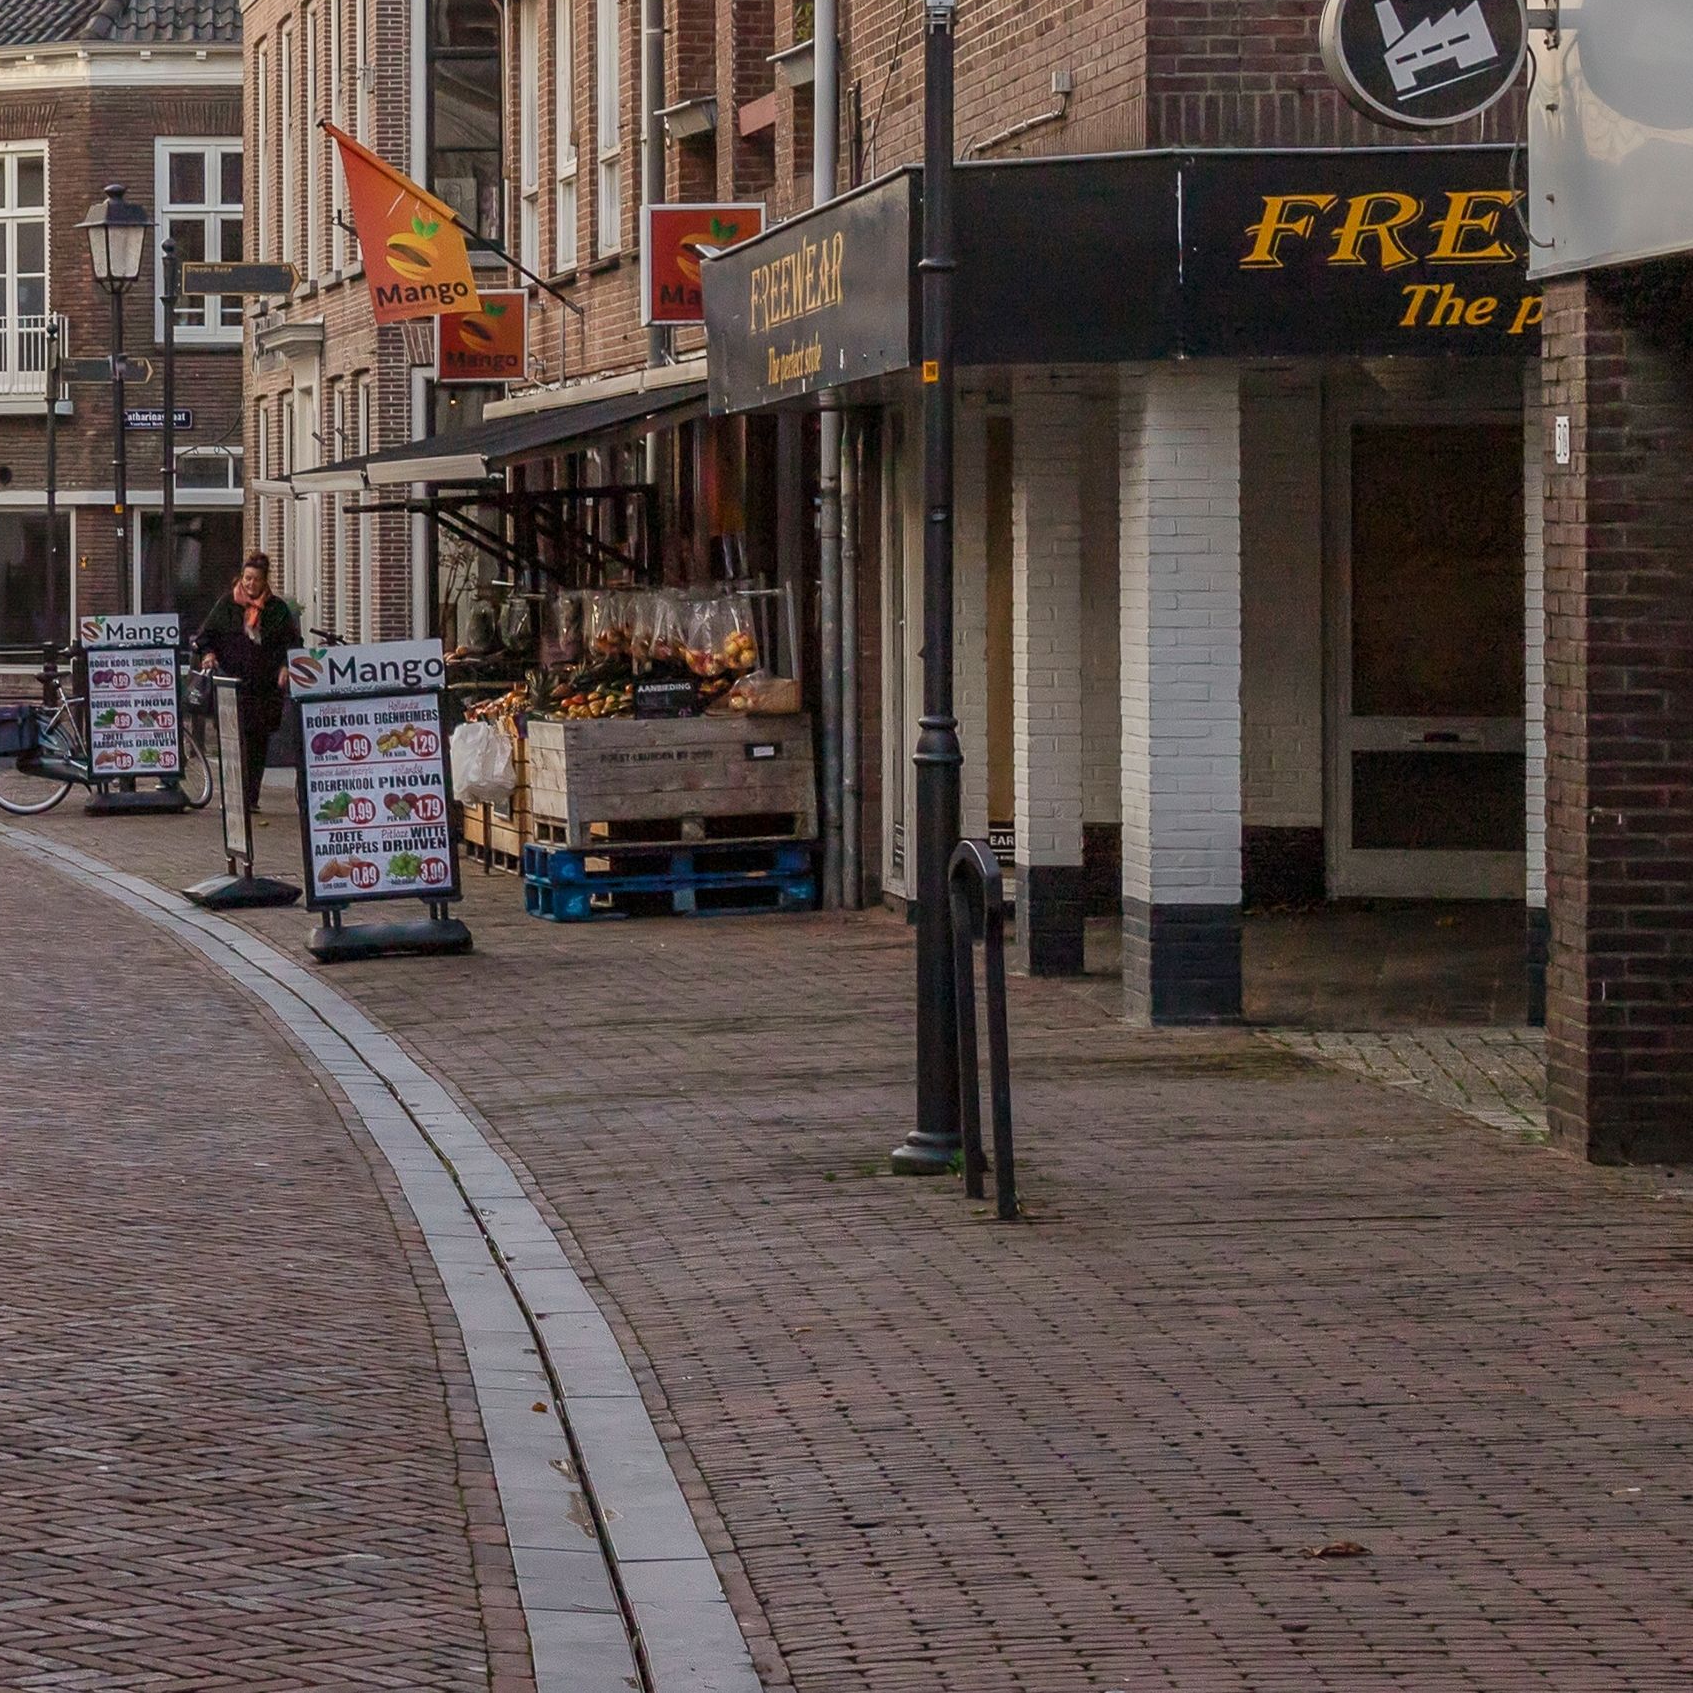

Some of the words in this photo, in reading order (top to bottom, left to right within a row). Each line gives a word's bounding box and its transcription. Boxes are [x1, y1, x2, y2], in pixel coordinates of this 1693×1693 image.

[750, 231, 844, 334] FREEWEAR
[376, 282, 468, 308] Mango
[1399, 284, 1496, 327] The
[446, 351, 518, 372] Mango
[768, 346, 780, 386] The
[780, 339, 804, 390] perfect
[105, 622, 179, 644] Mango
[328, 656, 445, 687] Mango
[637, 683, 691, 693] AANBIEDING
[134, 698, 174, 707] PINOVA
[306, 715, 337, 729] RODE
[340, 713, 371, 727] KOOL
[374, 709, 438, 724] EIGENHEIMERS
[136, 738, 176, 747] DRUIVEN
[343, 738, 368, 759] 0,99
[415, 735, 435, 754] 1,29
[310, 776, 374, 793] BOERENKOOL
[378, 773, 442, 788] PINOVA
[348, 802, 373, 822] 0,99
[416, 798, 440, 818] 1,79
[329, 830, 363, 843] ZOETE
[410, 825, 446, 838] WITTE
[315, 840, 379, 856] AARDAPPELS
[382, 837, 447, 853] DRUIVEN
[352, 866, 377, 885] 0,89
[420, 861, 445, 881] 3,99
